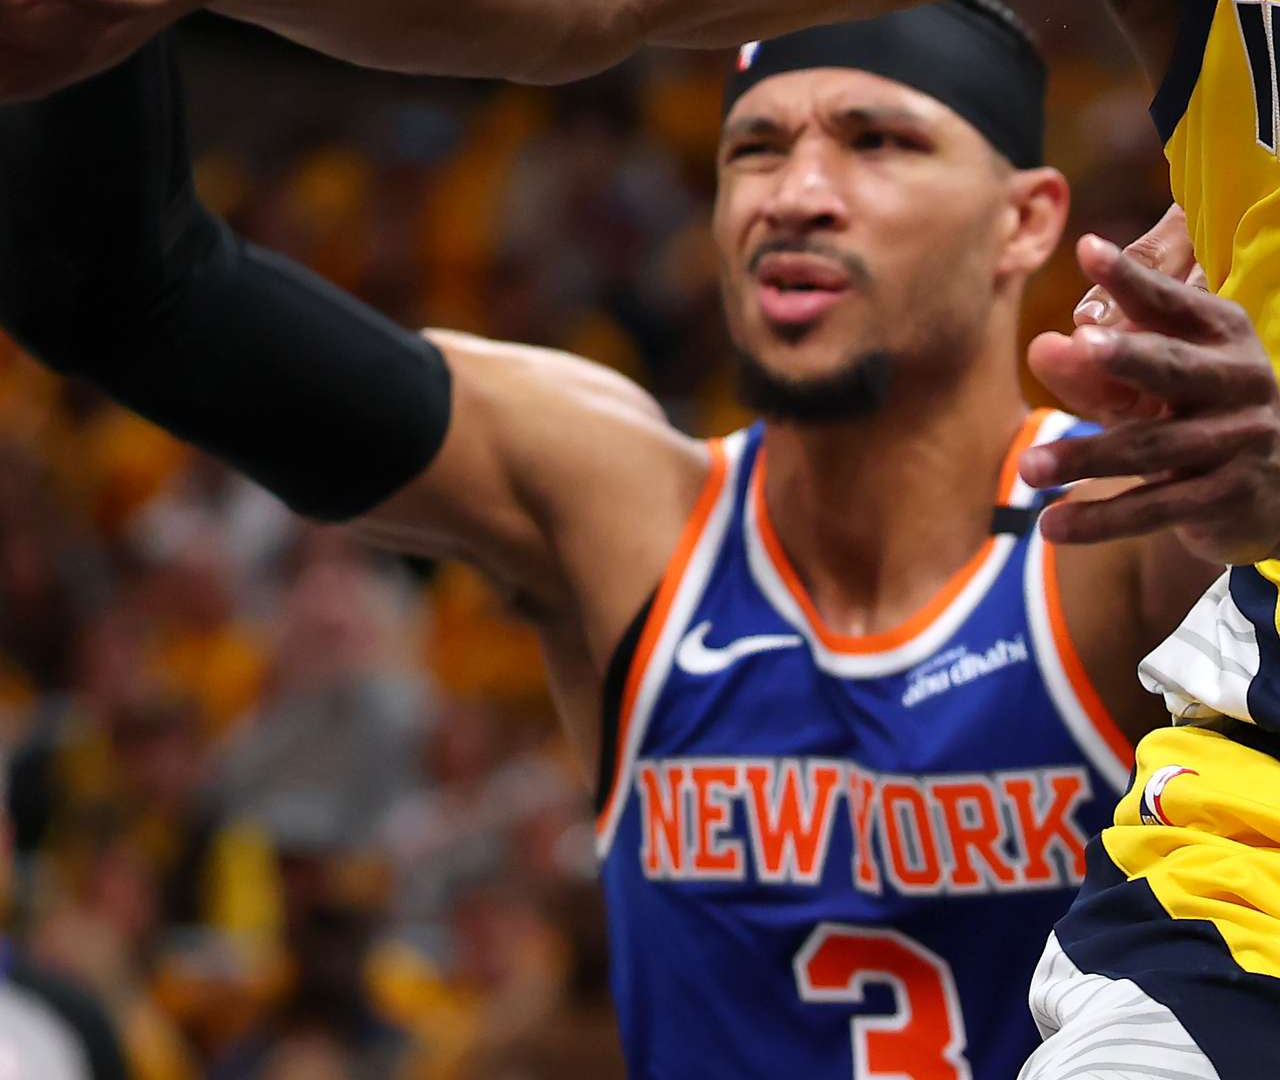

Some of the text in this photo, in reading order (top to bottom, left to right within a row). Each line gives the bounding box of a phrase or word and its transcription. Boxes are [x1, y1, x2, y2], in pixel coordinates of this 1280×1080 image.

[634, 758, 1094, 896] NEW YORK
[794, 922, 975, 1080] 3
